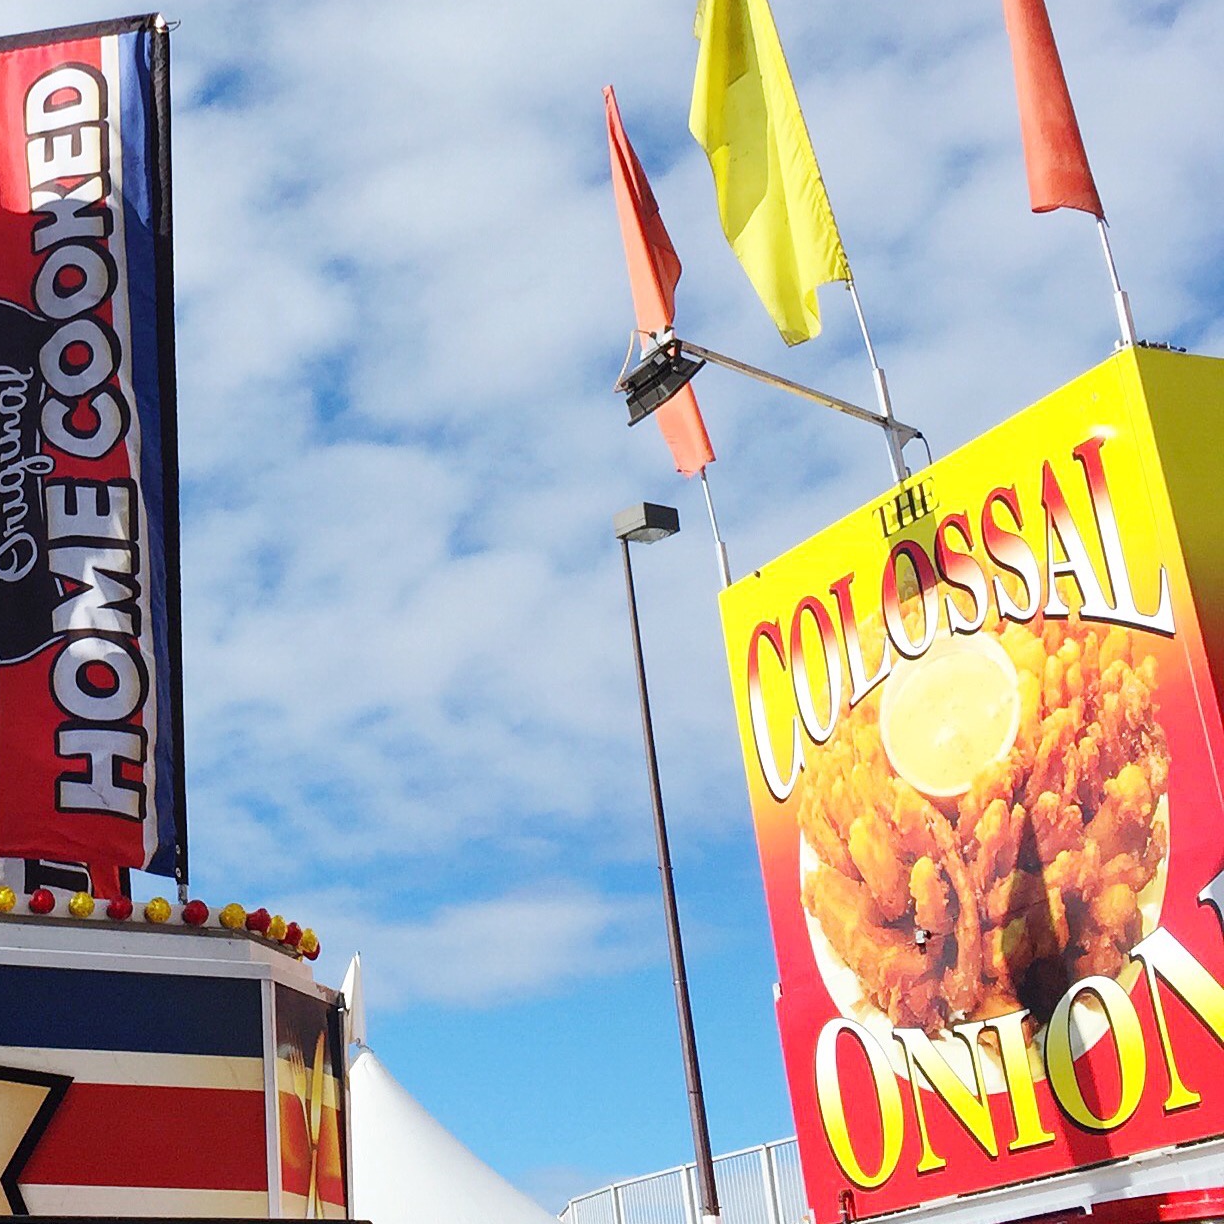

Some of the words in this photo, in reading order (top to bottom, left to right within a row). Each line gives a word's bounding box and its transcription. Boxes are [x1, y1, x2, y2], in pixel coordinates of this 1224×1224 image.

[23, 61, 130, 460] COOKED
[46, 477, 149, 822] HOME
[747, 435, 1176, 802] COLOSSAL
[872, 476, 940, 538] THE
